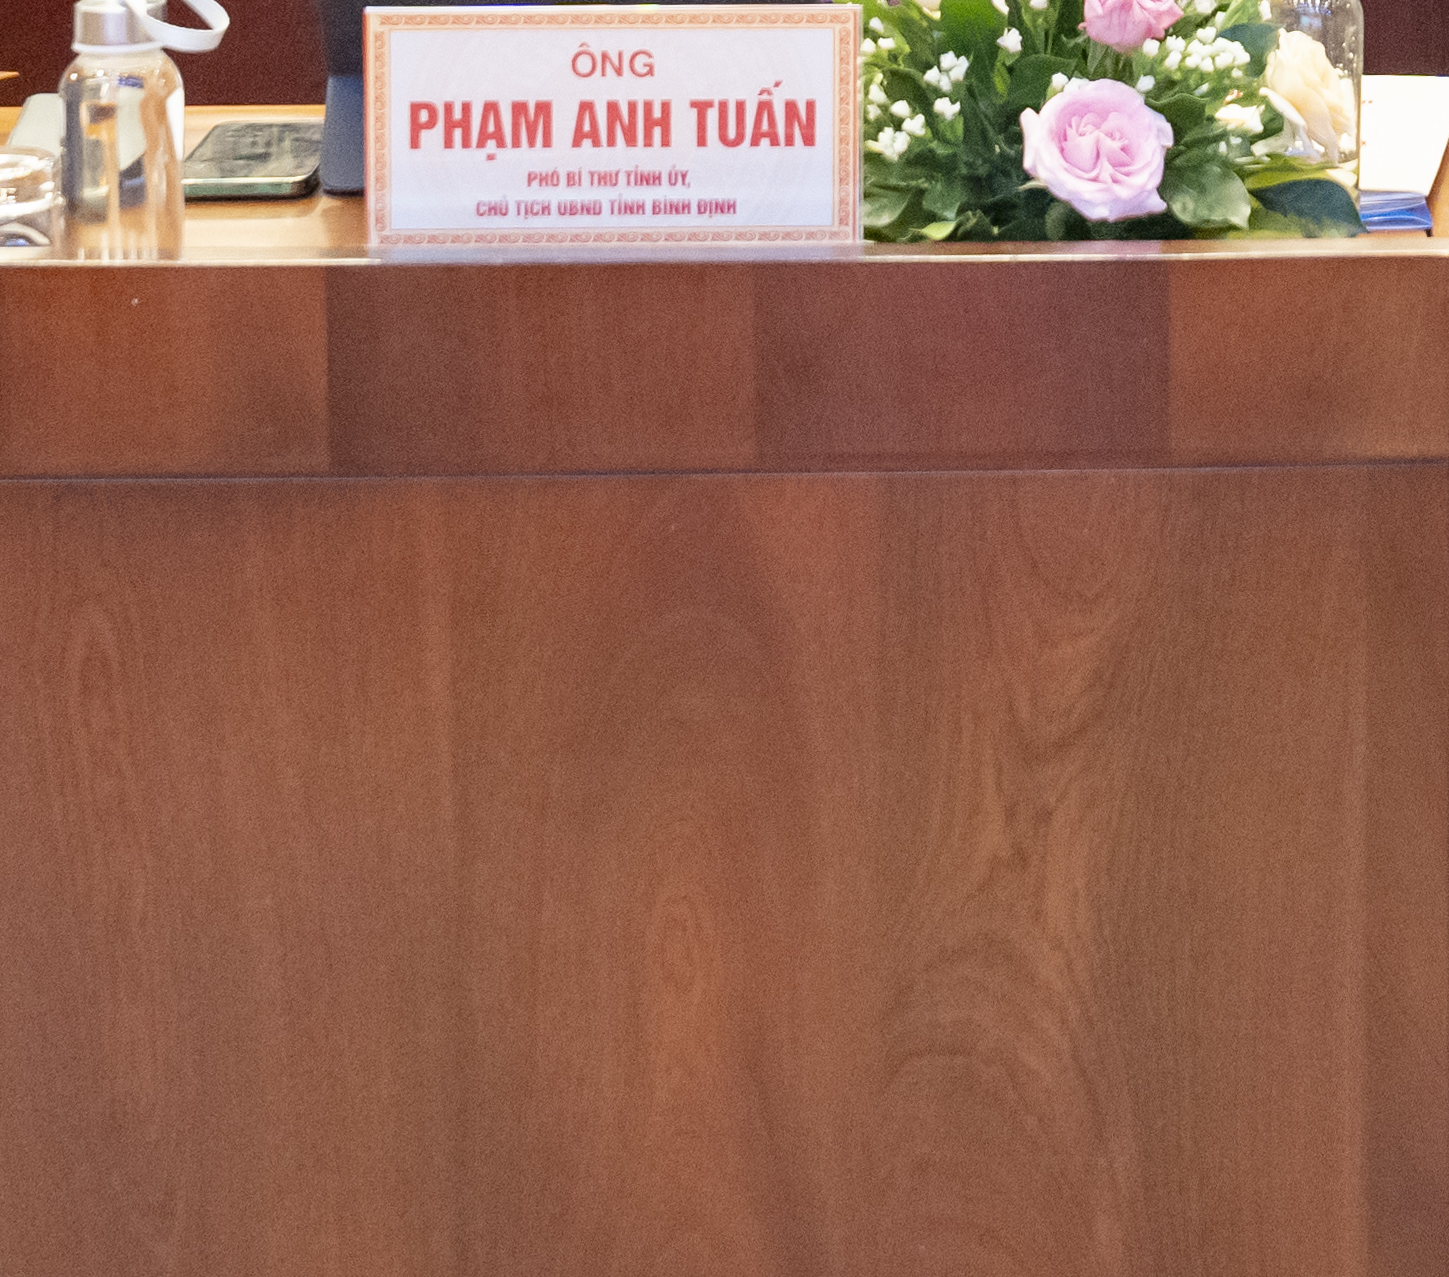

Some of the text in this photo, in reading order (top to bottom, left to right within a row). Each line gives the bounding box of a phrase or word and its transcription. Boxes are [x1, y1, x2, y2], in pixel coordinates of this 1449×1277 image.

[571, 43, 655, 79] ÔNG
[409, 80, 817, 162] PHẠM ANH TUẤN
[527, 167, 560, 187] PHÓ
[566, 167, 582, 187] BÍ
[588, 168, 619, 187] THƯ
[625, 164, 662, 187] TỈNH
[476, 194, 737, 219] CHỦ TỊCH UBND TỈNH BÌNH ĐỊNH
